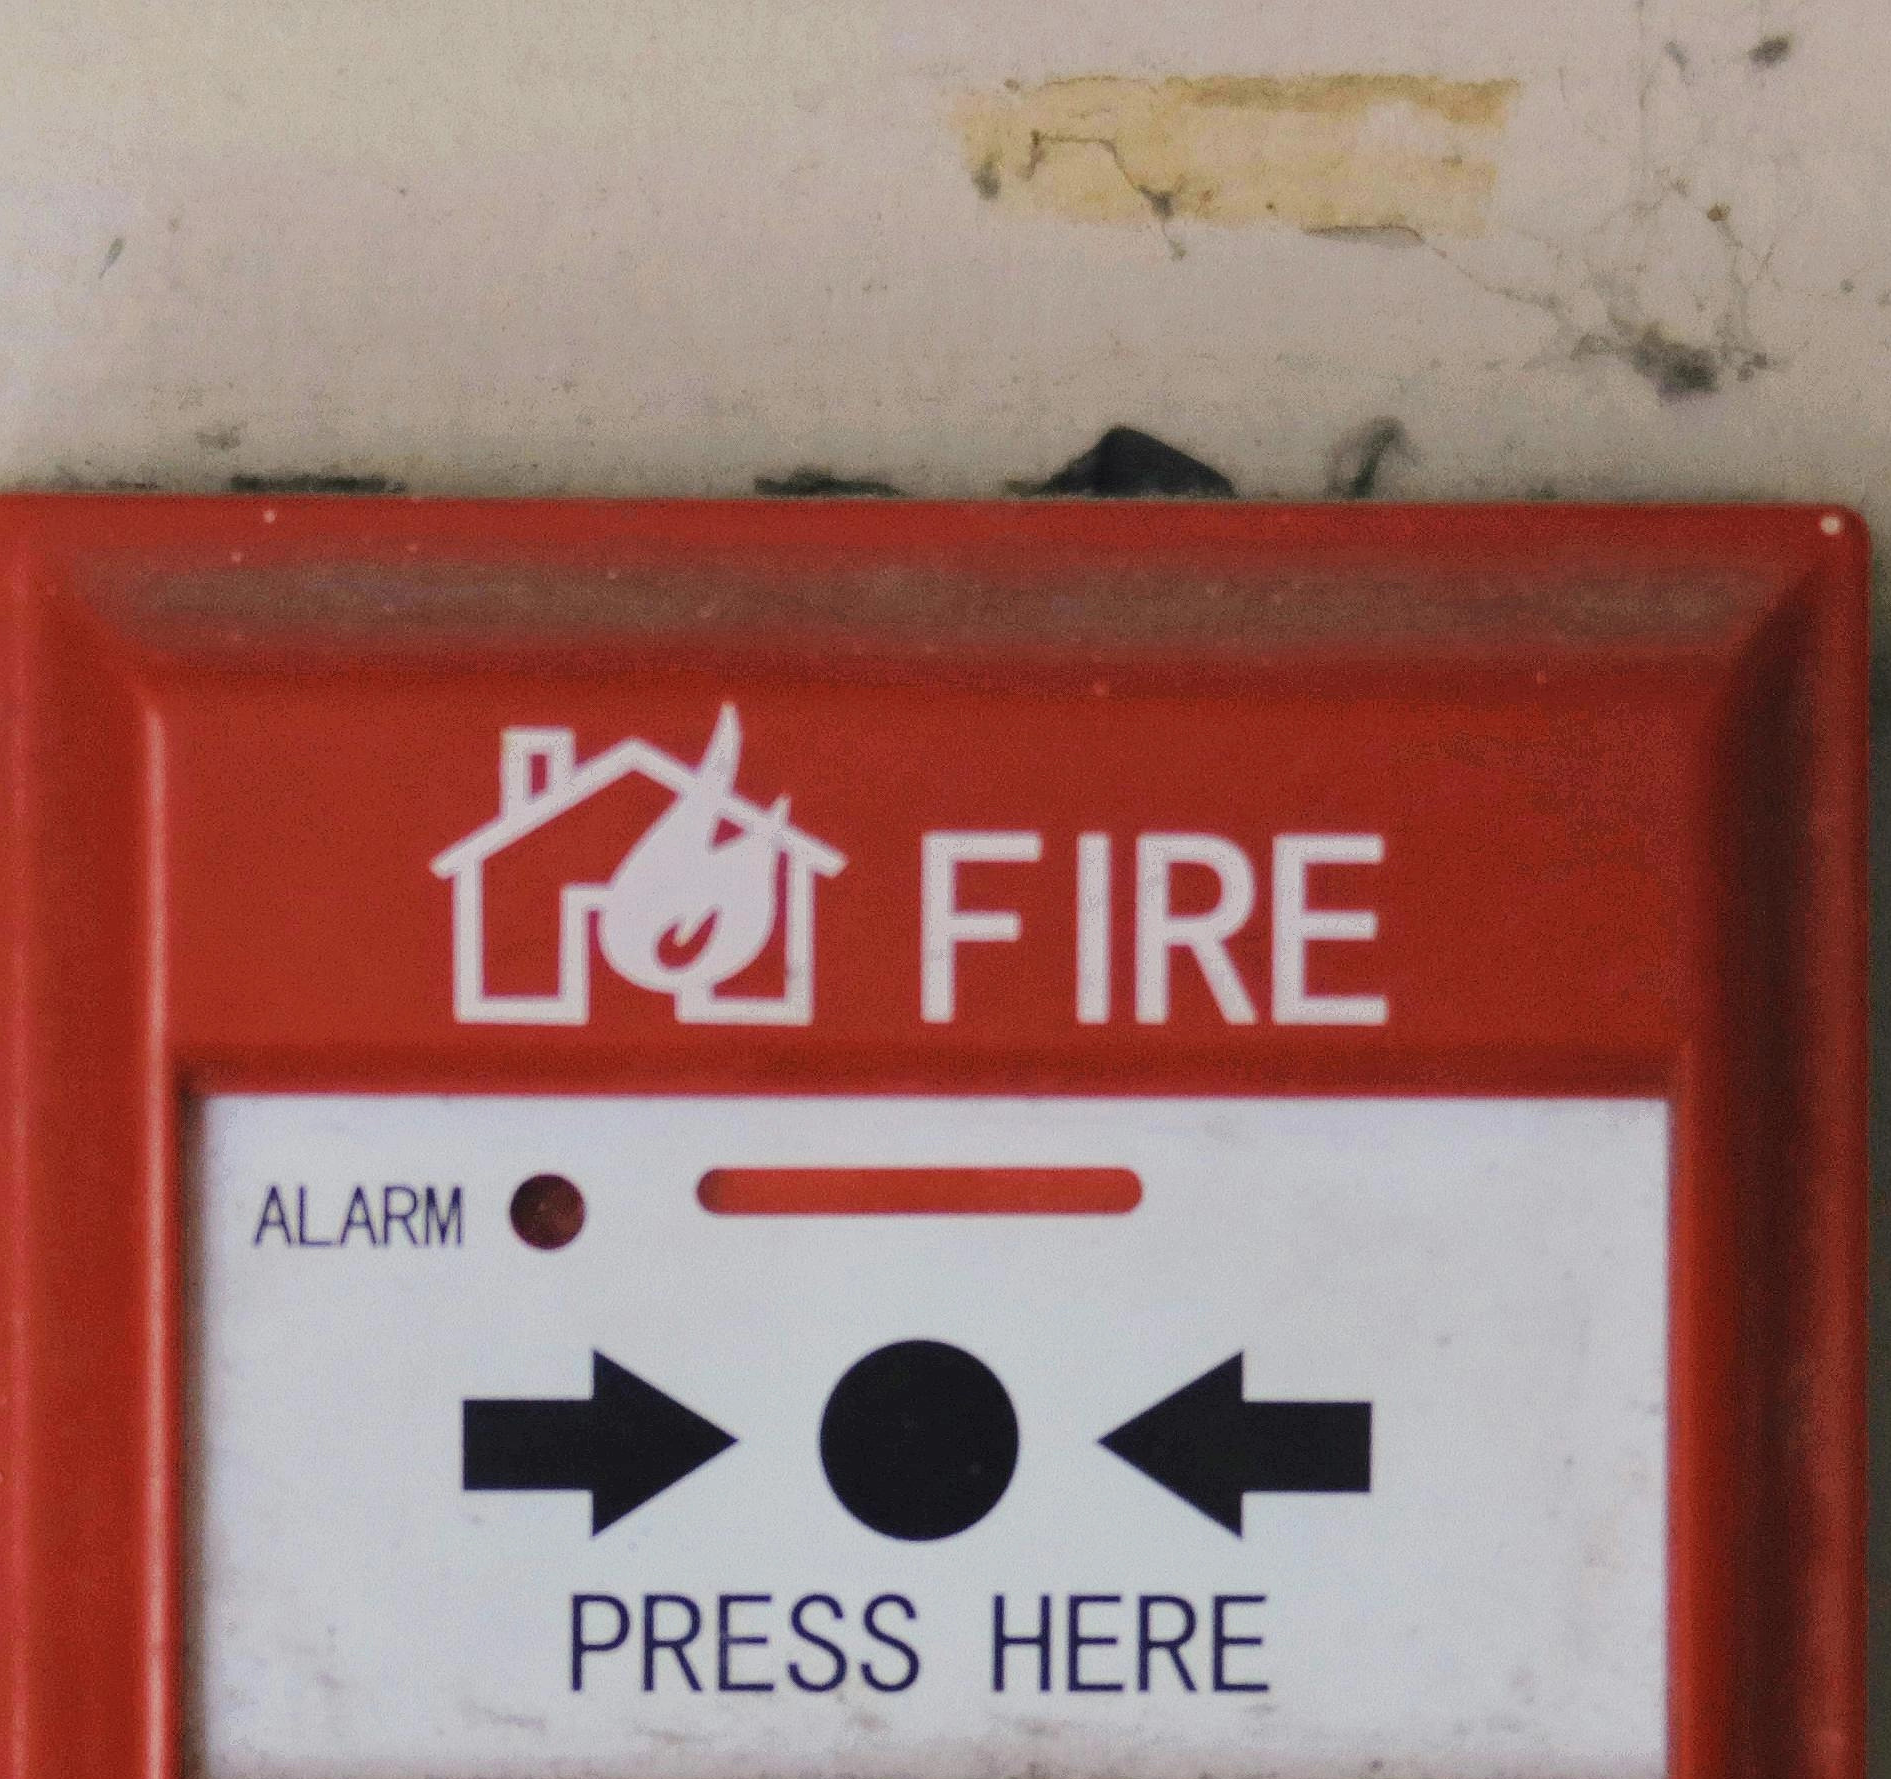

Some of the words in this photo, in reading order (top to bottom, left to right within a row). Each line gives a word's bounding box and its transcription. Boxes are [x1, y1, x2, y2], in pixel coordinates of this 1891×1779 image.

[921, 831, 1388, 1025] FIRE
[253, 1185, 464, 1246] ALARM
[570, 1592, 921, 1694] PRESS
[991, 1593, 1271, 1694] HERE
